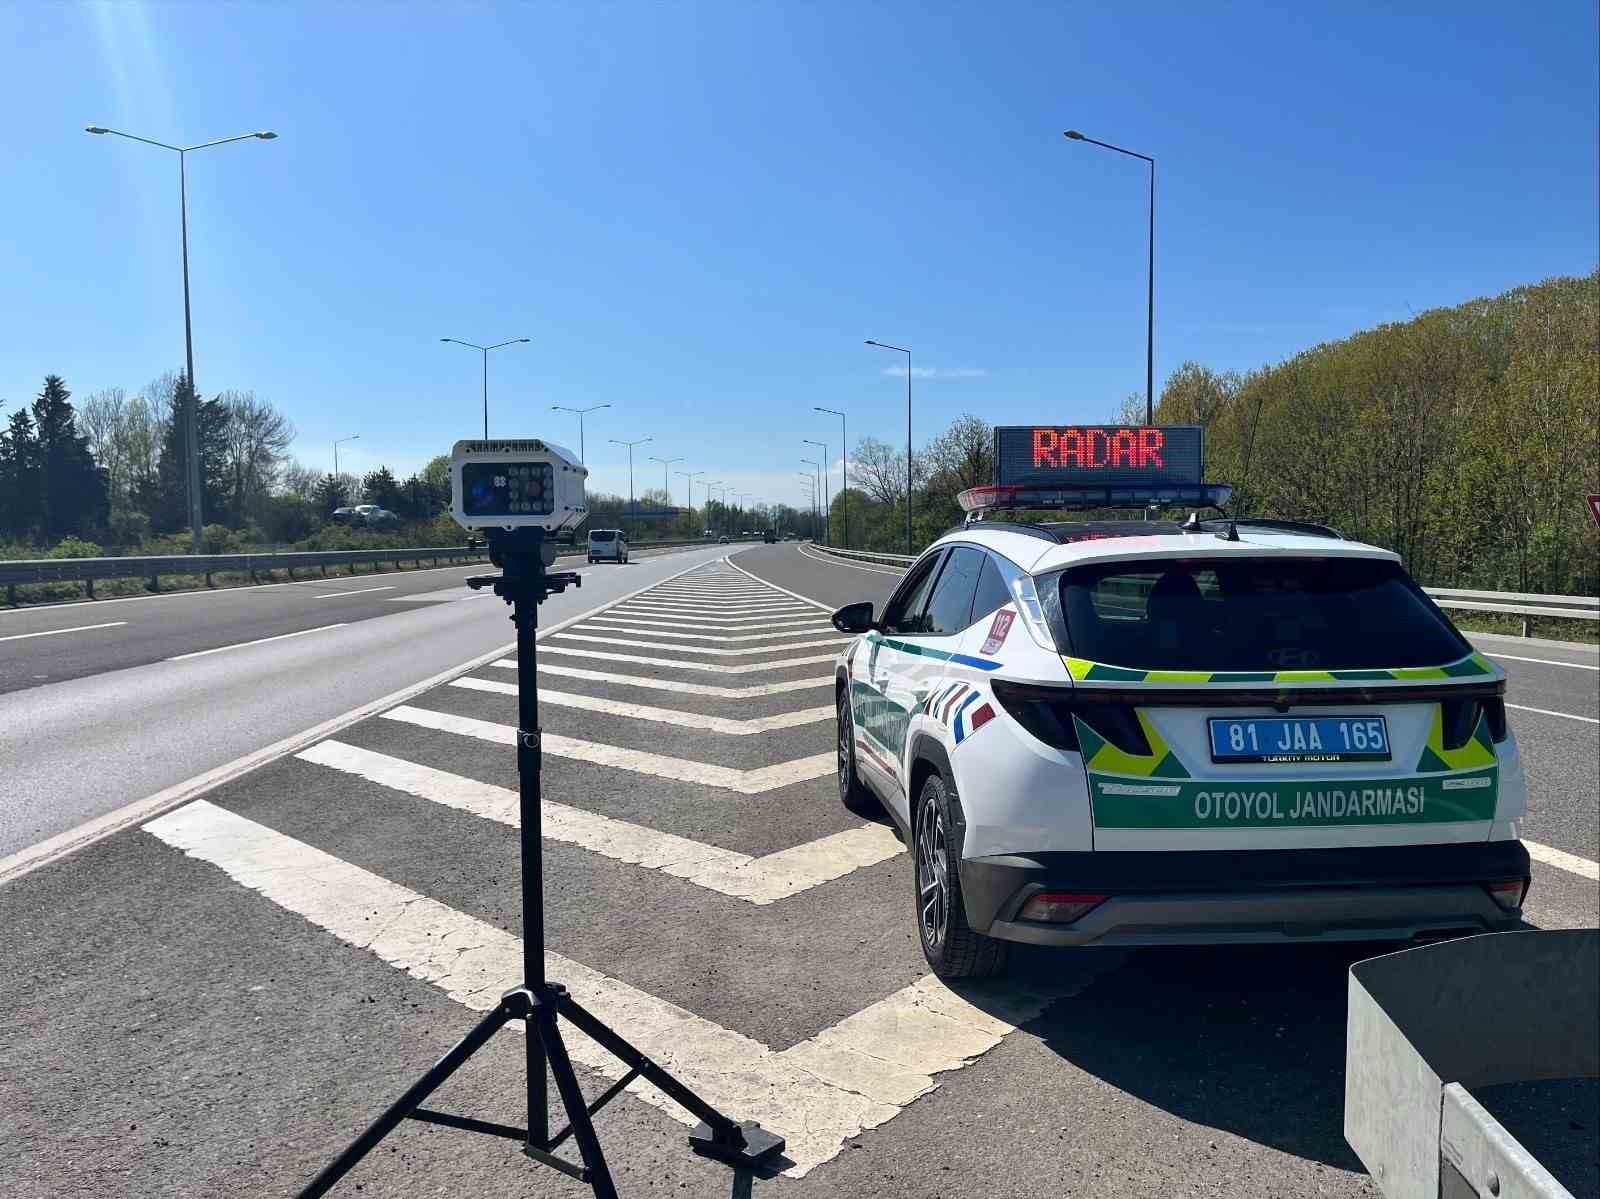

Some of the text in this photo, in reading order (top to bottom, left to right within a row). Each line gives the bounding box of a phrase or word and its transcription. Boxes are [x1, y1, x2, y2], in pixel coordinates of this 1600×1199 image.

[1033, 429, 1162, 468] RADAR
[1229, 721, 1383, 751] 81 JAA 165
[1194, 786, 1425, 819] OTOYOL JANDARMASI
